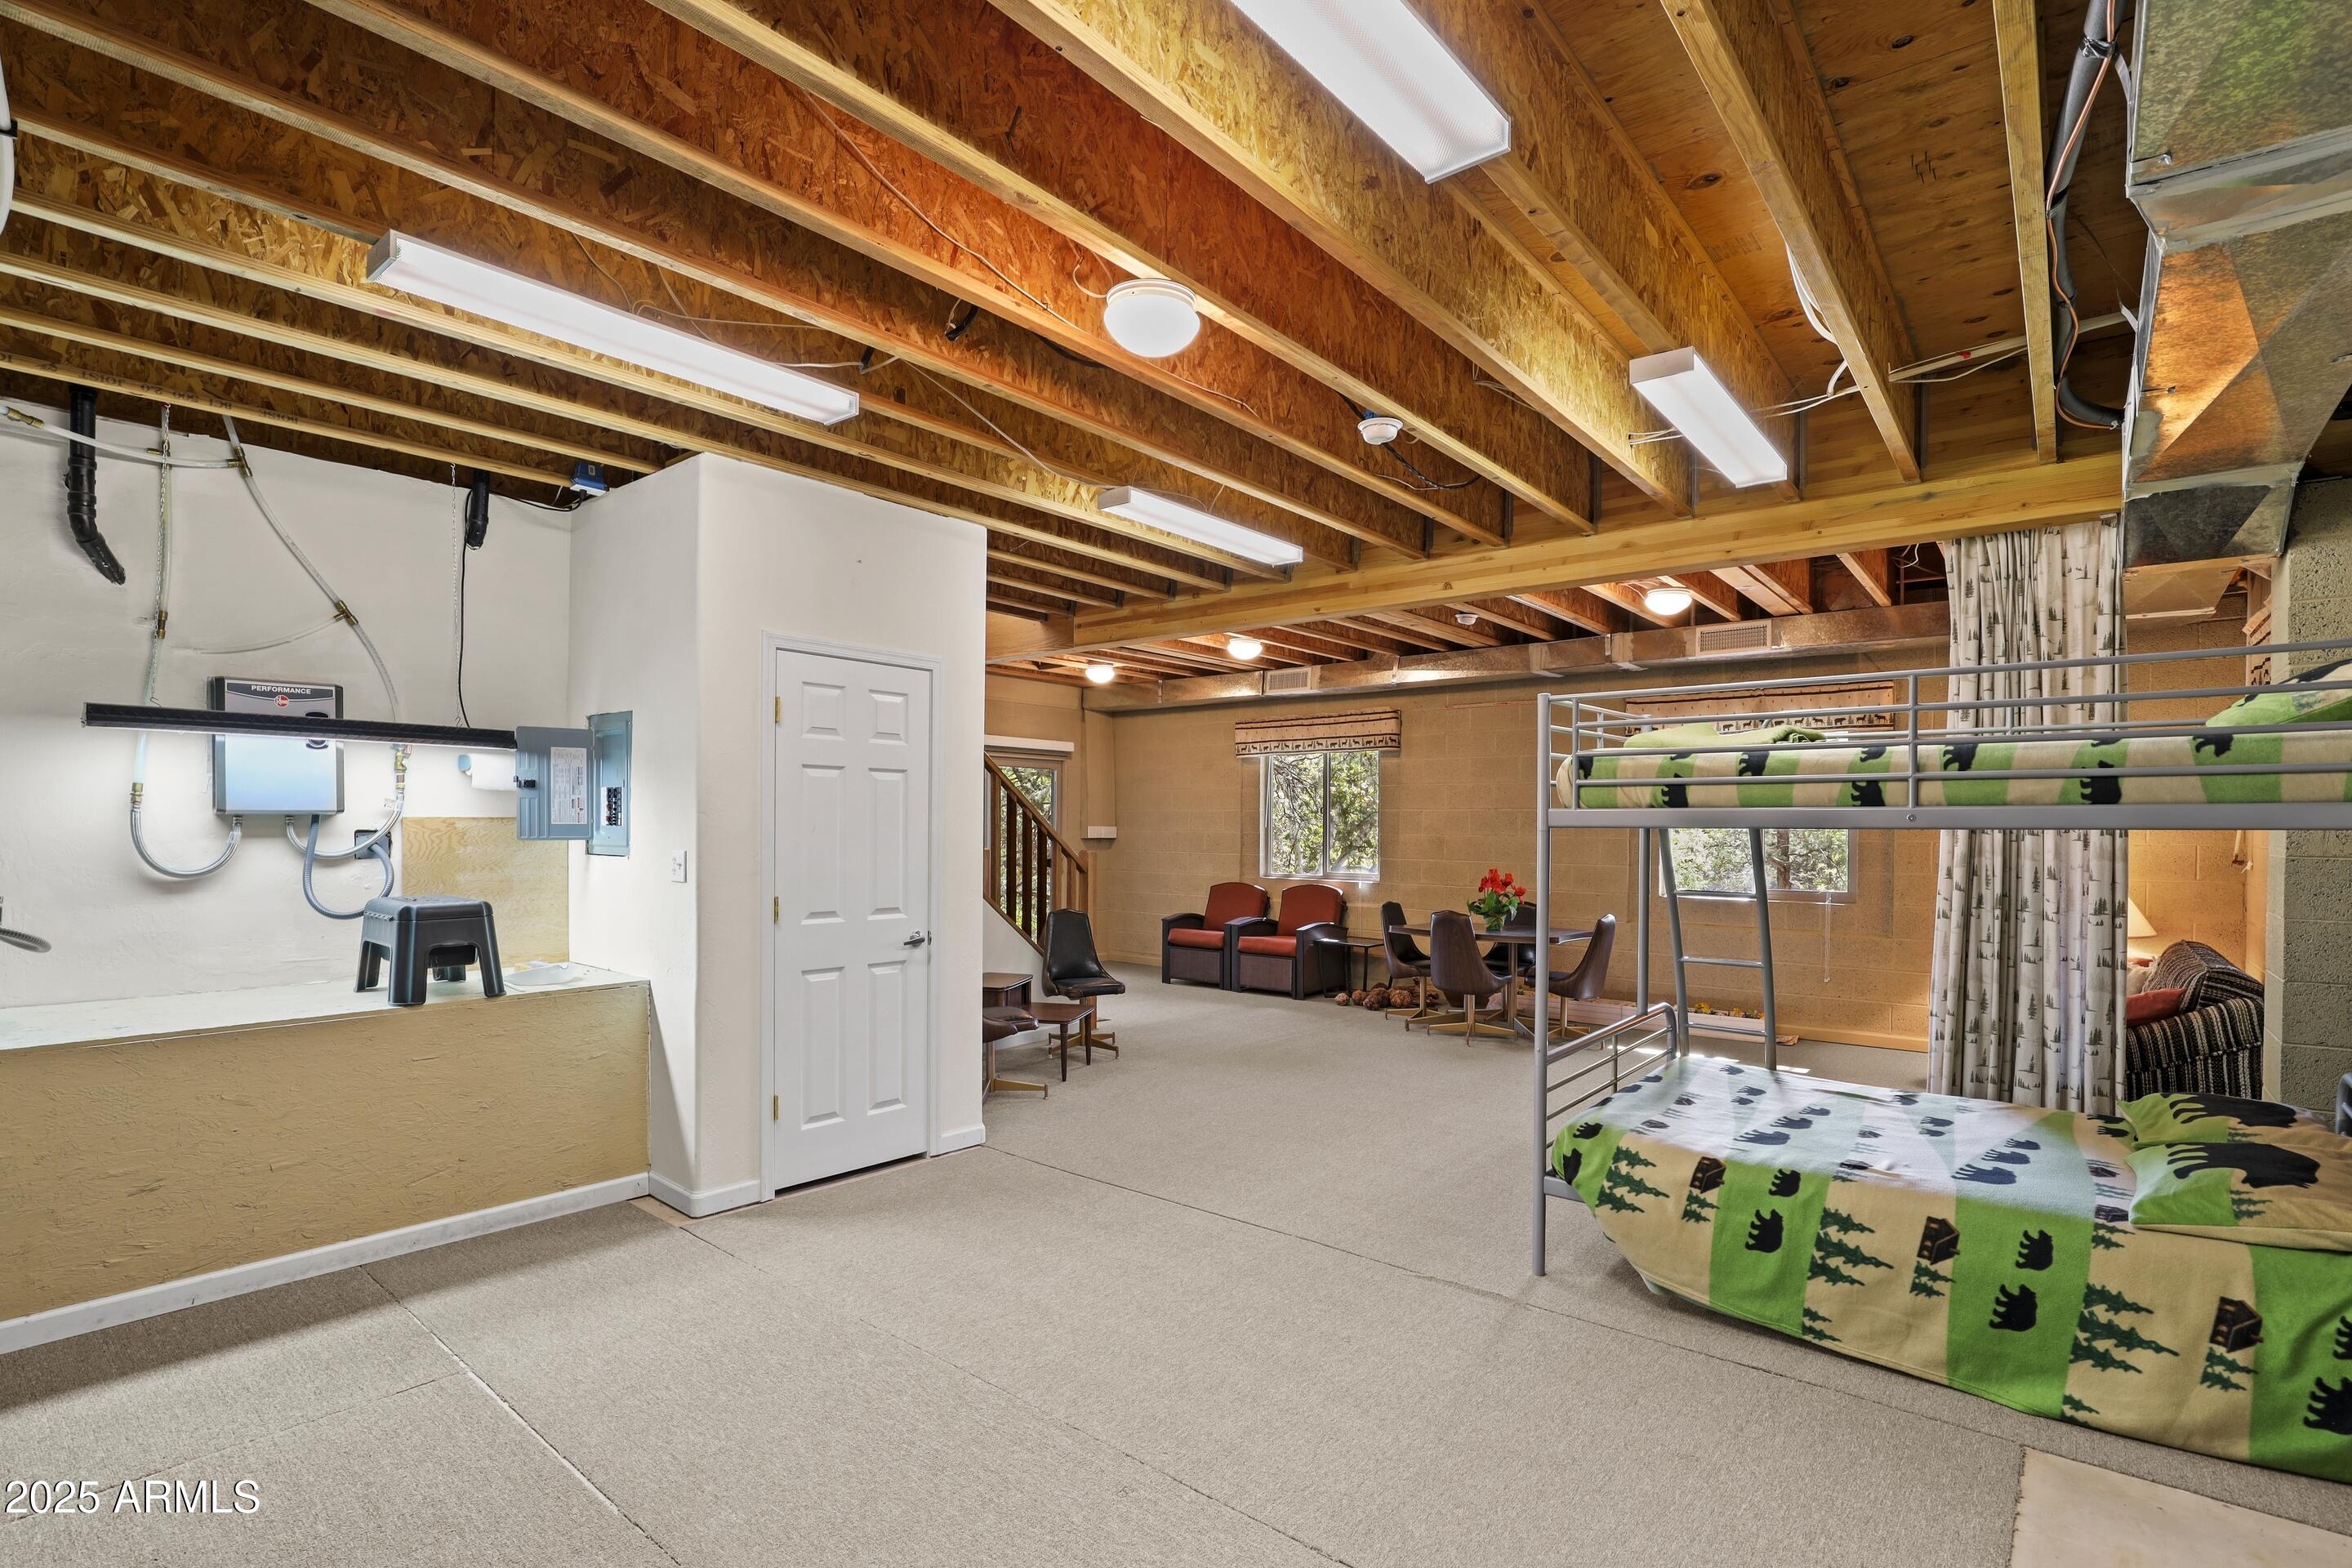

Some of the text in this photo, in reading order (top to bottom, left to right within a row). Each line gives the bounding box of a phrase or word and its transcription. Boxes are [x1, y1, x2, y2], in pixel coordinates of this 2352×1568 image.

[78, 371, 125, 386] JOIST
[172, 391, 199, 403] 500
[209, 398, 232, 410] BCI
[251, 685, 311, 694] PERFORMANCE
